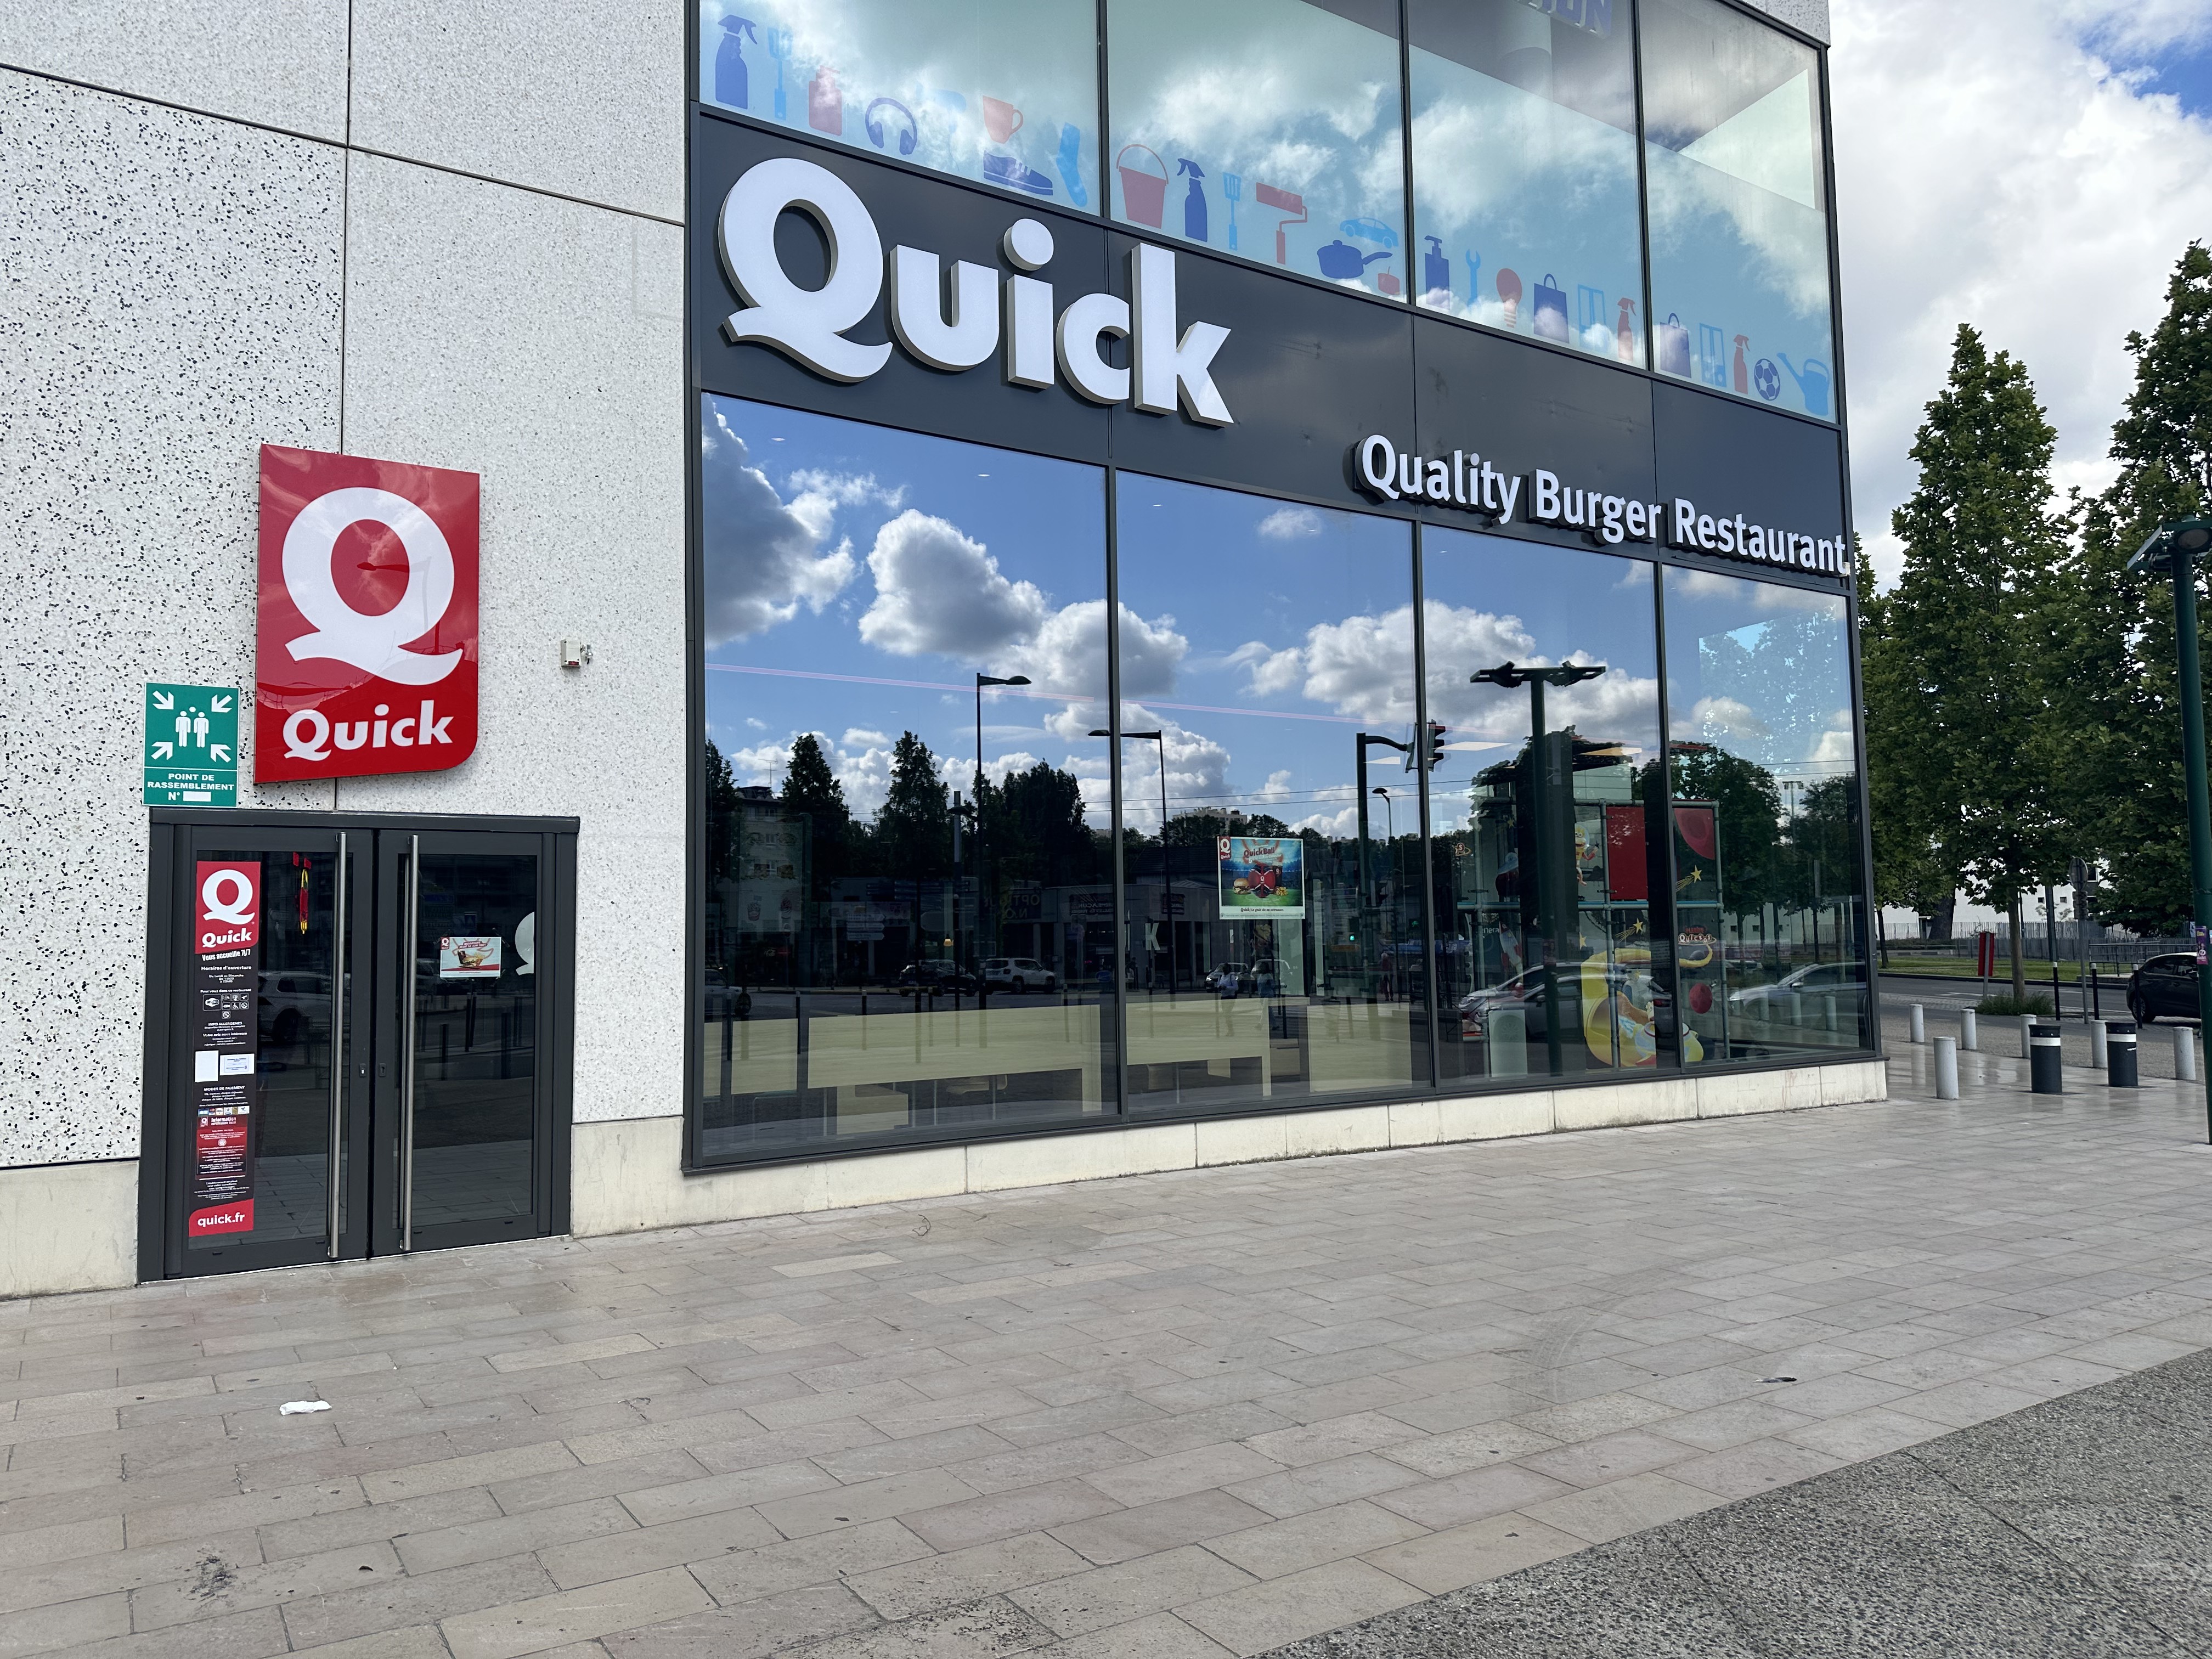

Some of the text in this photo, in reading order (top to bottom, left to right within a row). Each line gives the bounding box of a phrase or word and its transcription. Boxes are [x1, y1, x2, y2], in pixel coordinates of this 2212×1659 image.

[718, 157, 1234, 427] Quick
[1359, 434, 1846, 574] Quality Burger Restaurant
[282, 487, 464, 686] Q
[283, 699, 454, 761] Quick
[147, 781, 234, 791] RASSEMBLEMENT
[168, 792, 180, 800] N°
[202, 869, 255, 925] Q
[202, 928, 252, 948] Quick
[216, 950, 241, 960] accueille
[198, 1212, 245, 1228] quick.fr
